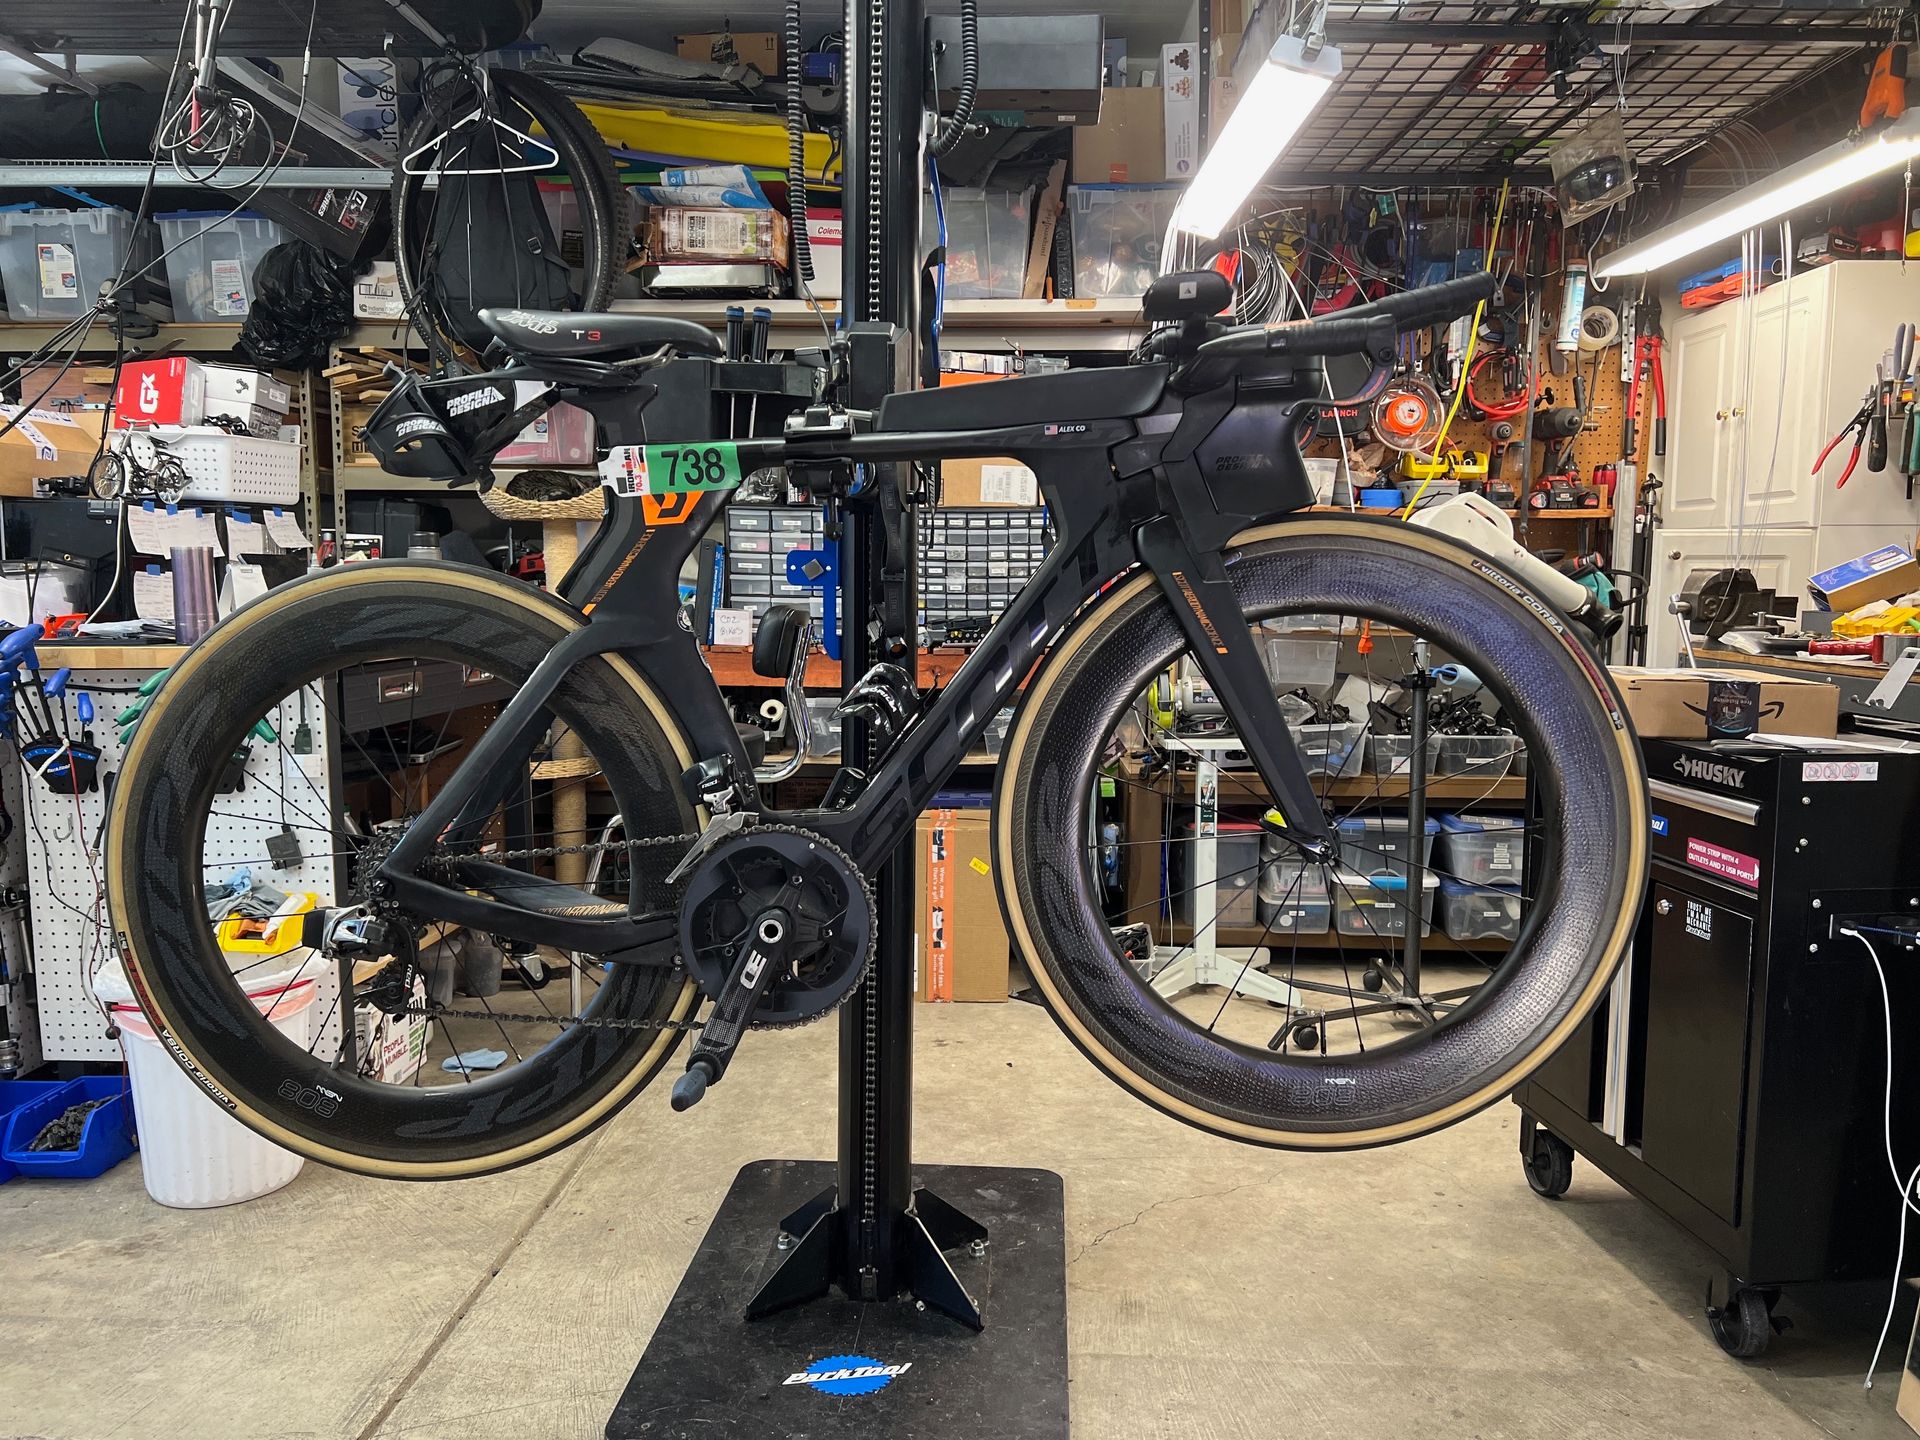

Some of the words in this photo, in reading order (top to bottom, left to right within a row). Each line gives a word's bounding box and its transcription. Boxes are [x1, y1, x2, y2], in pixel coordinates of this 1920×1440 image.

[139, 372, 160, 414] GX
[446, 386, 492, 410] PROFILE
[449, 396, 491, 418] DESIGN
[395, 419, 438, 433] PROFILE
[397, 424, 437, 438] DESIGN
[1058, 425, 1075, 433] ALEX
[621, 447, 635, 493] IRONMAN
[661, 447, 726, 487] 738
[634, 474, 643, 493] 70.3
[1481, 565, 1521, 596] vittoria
[1522, 594, 1565, 635] CORSA
[1690, 758, 1747, 789] HUSKY
[1688, 841, 1707, 854] POWER
[1707, 848, 1721, 858] STRIP
[1721, 852, 1734, 863] WITH
[1688, 852, 1709, 865] OUTLETS
[1709, 859, 1721, 870] AND
[1725, 865, 1736, 875] USB
[1736, 869, 1754, 881] PORTS
[1687, 900, 1702, 912] TRUST
[1704, 906, 1712, 914] ME
[1700, 912, 1712, 925] BIKE
[1686, 916, 1711, 933] MECHANIC
[162, 1029, 195, 1070] CORSA
[383, 1034, 405, 1055] PEOPLE
[197, 1070, 230, 1108] vittoria
[278, 1078, 339, 1118] 808
[1291, 1085, 1356, 1106] 808
[782, 1362, 913, 1386] ParkTool
